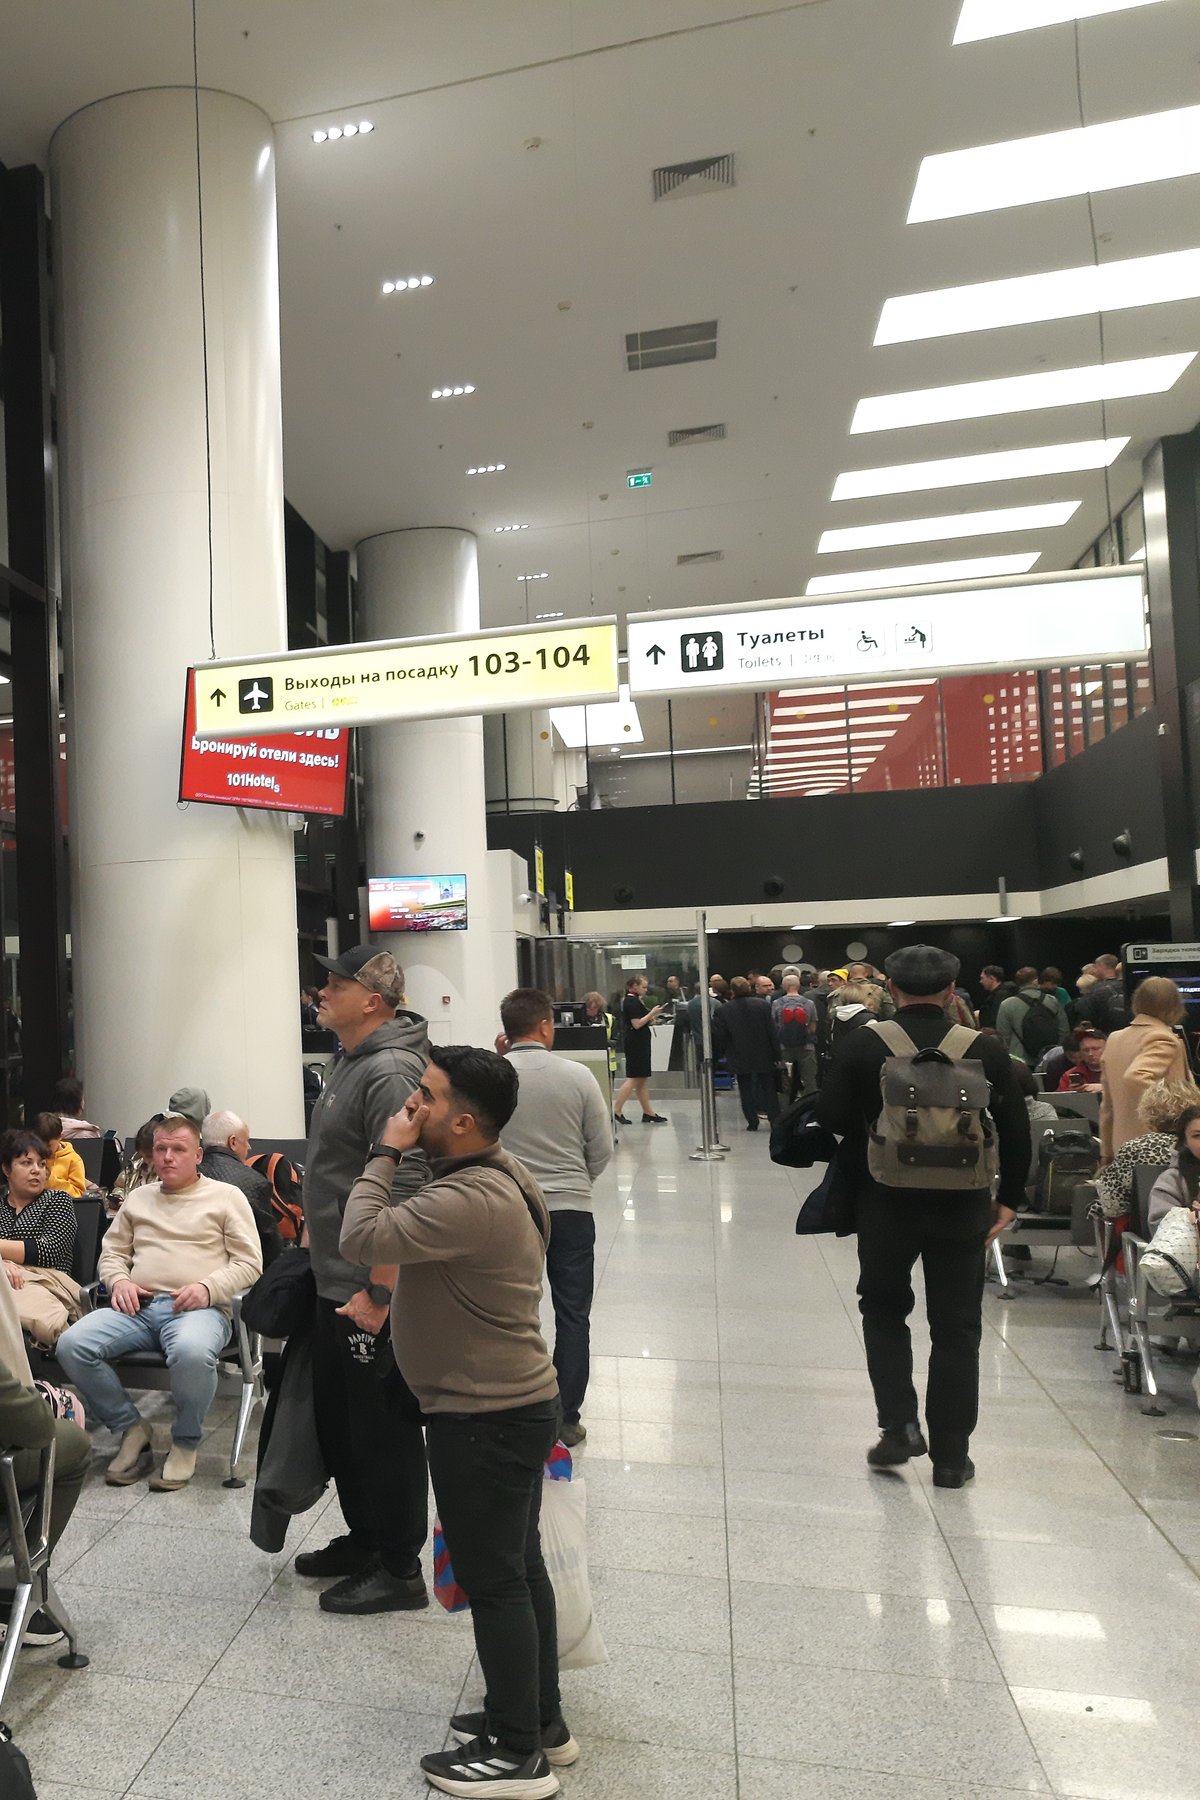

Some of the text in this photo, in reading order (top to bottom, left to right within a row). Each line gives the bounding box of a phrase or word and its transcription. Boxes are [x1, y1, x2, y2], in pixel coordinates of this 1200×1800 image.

[736, 628, 824, 648] Туалеты
[284, 644, 590, 692] Выходы на посадку 103-104
[738, 655, 782, 669] Toilets
[284, 700, 317, 711] Gates
[259, 748, 297, 762] отели
[298, 752, 339, 768] здесь!
[226, 773, 280, 793] 101Hotels
